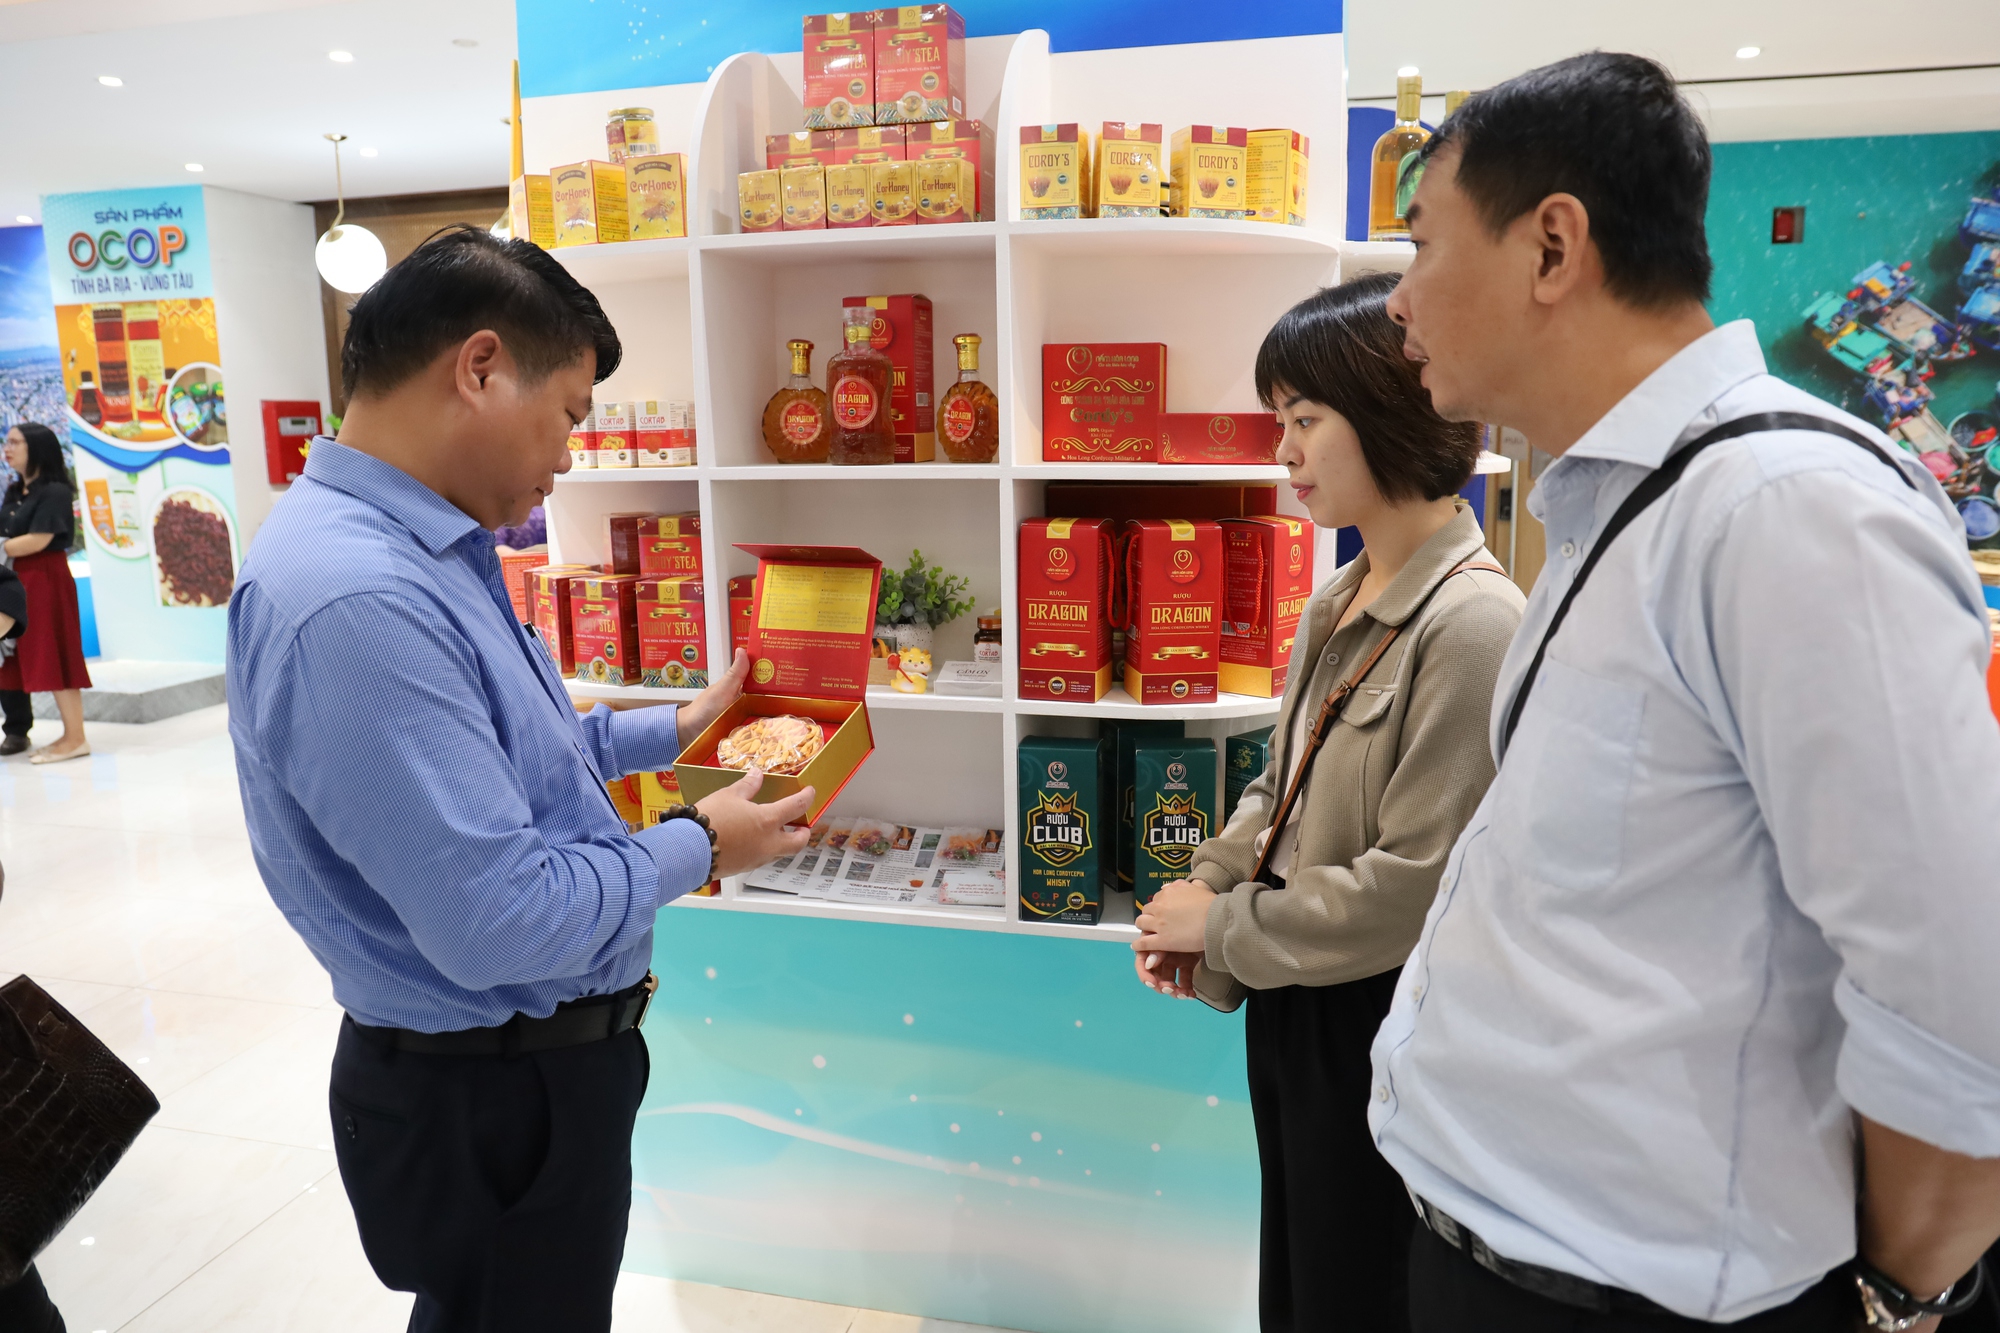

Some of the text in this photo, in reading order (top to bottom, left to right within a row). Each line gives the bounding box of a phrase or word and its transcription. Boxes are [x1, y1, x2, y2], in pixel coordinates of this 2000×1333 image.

[1029, 153, 1070, 168] CORDY'S
[1110, 151, 1153, 165] CORDY'S
[1198, 155, 1238, 170] CORDY'S
[630, 180, 678, 193] CorHoney
[832, 185, 864, 197] CorHoney
[876, 181, 910, 194] CorHoney
[922, 179, 956, 192] CorHoney
[555, 187, 591, 202] CorHoney
[133, 201, 183, 221] PHẨM
[68, 224, 186, 270] OCOP
[172, 270, 194, 289] TÀU
[837, 394, 869, 404] DRAGON
[599, 417, 625, 426] CORTAB
[640, 416, 666, 425] CORTAB
[950, 410, 972, 420] DRAGON
[1070, 407, 1134, 426] Cordy's
[1028, 603, 1088, 621] DRAGON
[1151, 606, 1212, 624] DRAGON
[1046, 813, 1069, 825] RƯỢU
[1164, 814, 1187, 827] RƯỢU
[1033, 825, 1083, 845] CLUB
[1149, 827, 1201, 846] CLUB
[1046, 878, 1071, 887] WHISKY
